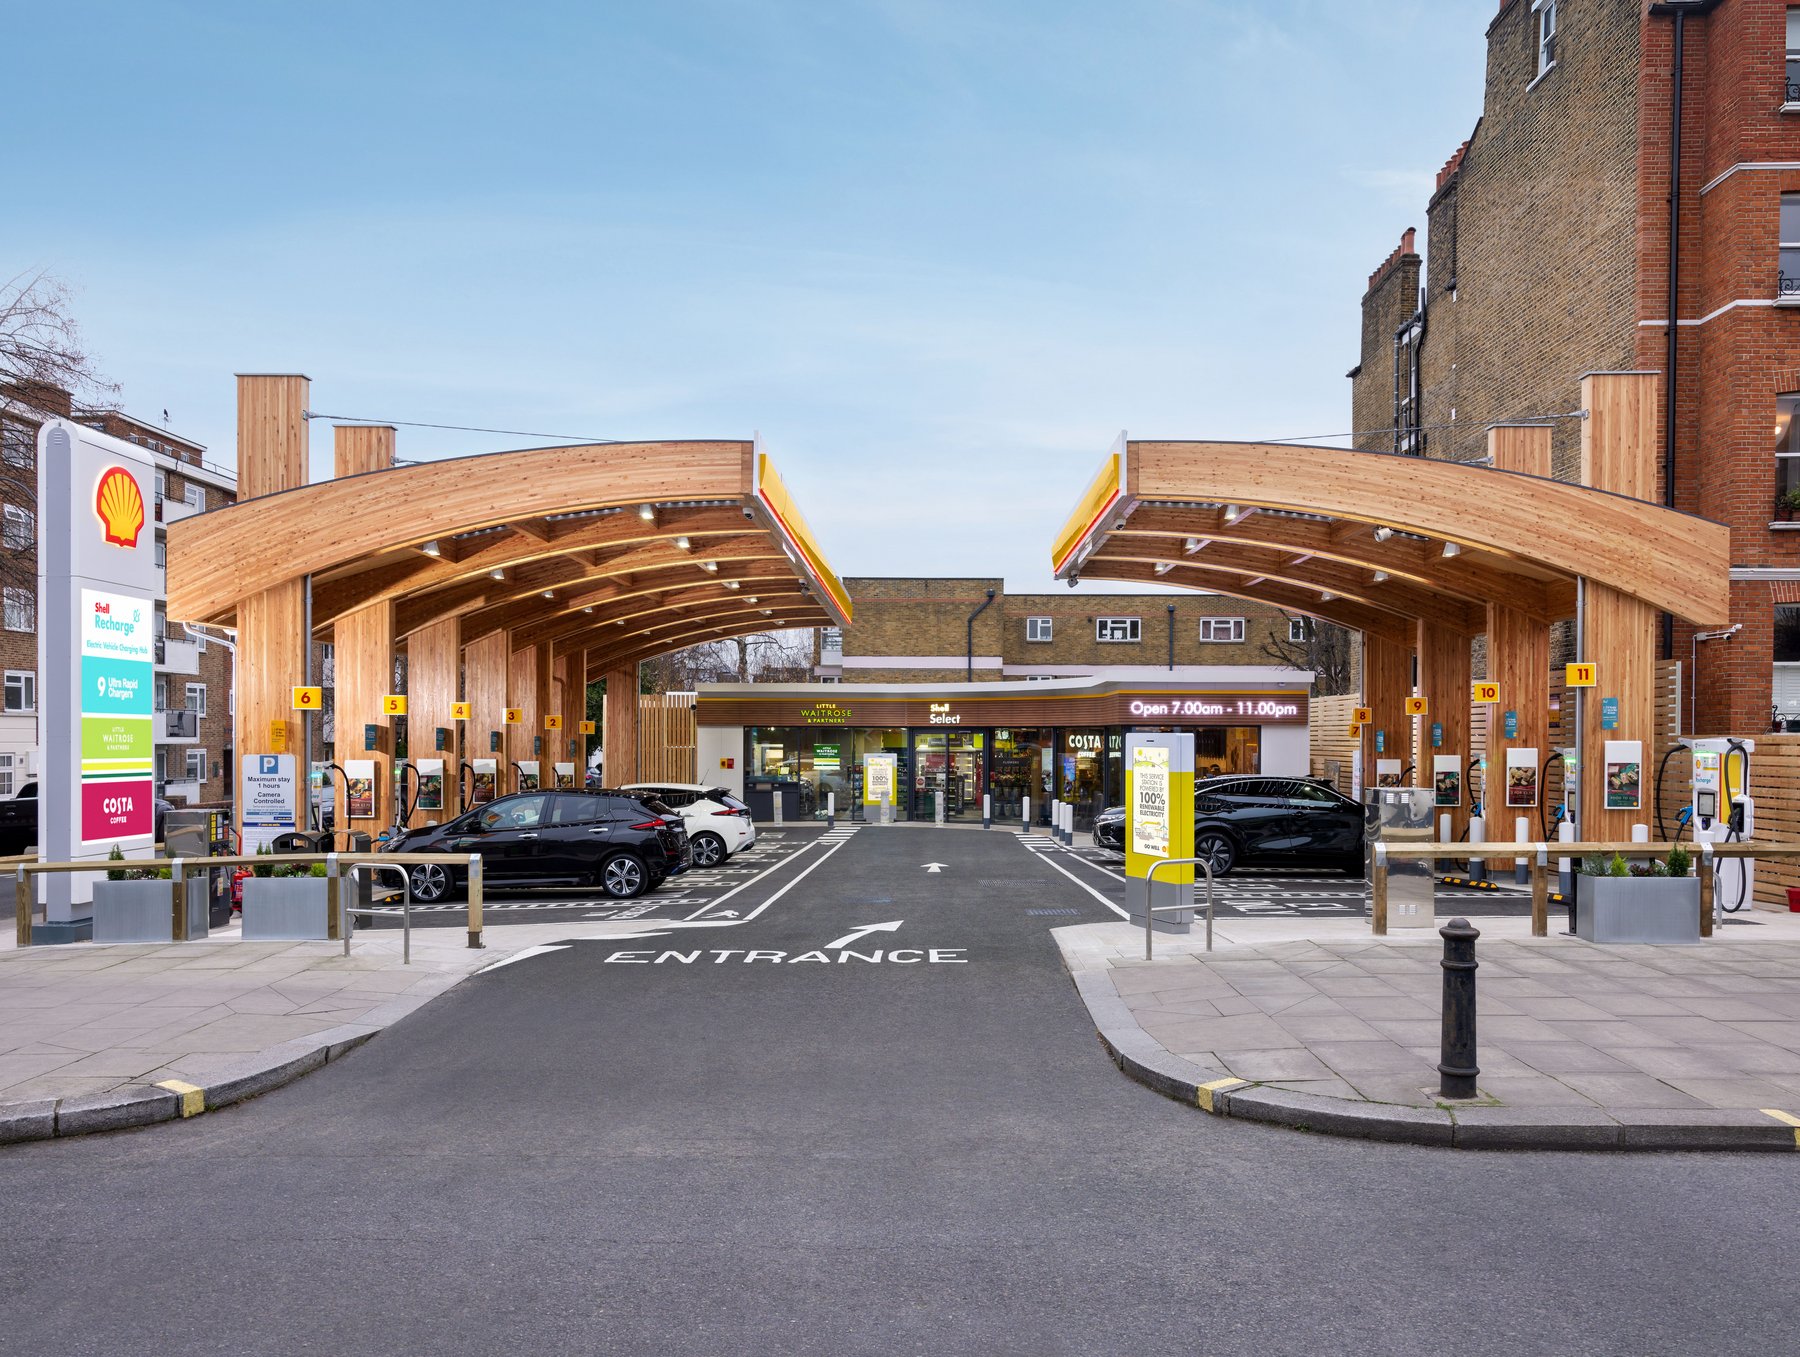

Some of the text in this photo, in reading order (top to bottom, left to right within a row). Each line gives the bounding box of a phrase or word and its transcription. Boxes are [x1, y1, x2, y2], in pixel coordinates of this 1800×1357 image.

[95, 602, 110, 614] Shell
[95, 614, 135, 636] Recharge
[86, 640, 148, 655] Electric Vehicle Charging Hub
[1577, 668, 1589, 680] 11
[97, 676, 106, 697] 9
[108, 677, 139, 690] Ultra Rapid
[108, 687, 133, 701] Chargers
[301, 692, 311, 704] 6
[1481, 687, 1496, 698] 10
[390, 700, 398, 710] 5
[456, 706, 464, 715] 4
[930, 703, 950, 712] Shell
[1130, 701, 1168, 717] Open
[1172, 701, 1223, 715] 7.00am
[1237, 701, 1297, 717] 11.00pm
[1413, 701, 1422, 711] 9
[508, 712, 515, 721] 3
[801, 709, 852, 717] WAITROSE
[929, 713, 961, 724] Select
[1359, 711, 1366, 720] 8
[550, 718, 556, 727] 2
[1352, 726, 1359, 735] 7
[102, 733, 134, 743] WAITROSE
[1068, 735, 1102, 749] COSTA
[1140, 791, 1166, 805] 100%
[103, 797, 133, 815] COSTA
[1139, 803, 1165, 812] RENEWABLE
[1139, 809, 1165, 818] ELECTRICITY
[109, 816, 127, 824] COFFEE
[604, 948, 968, 964] ENTRANCE
